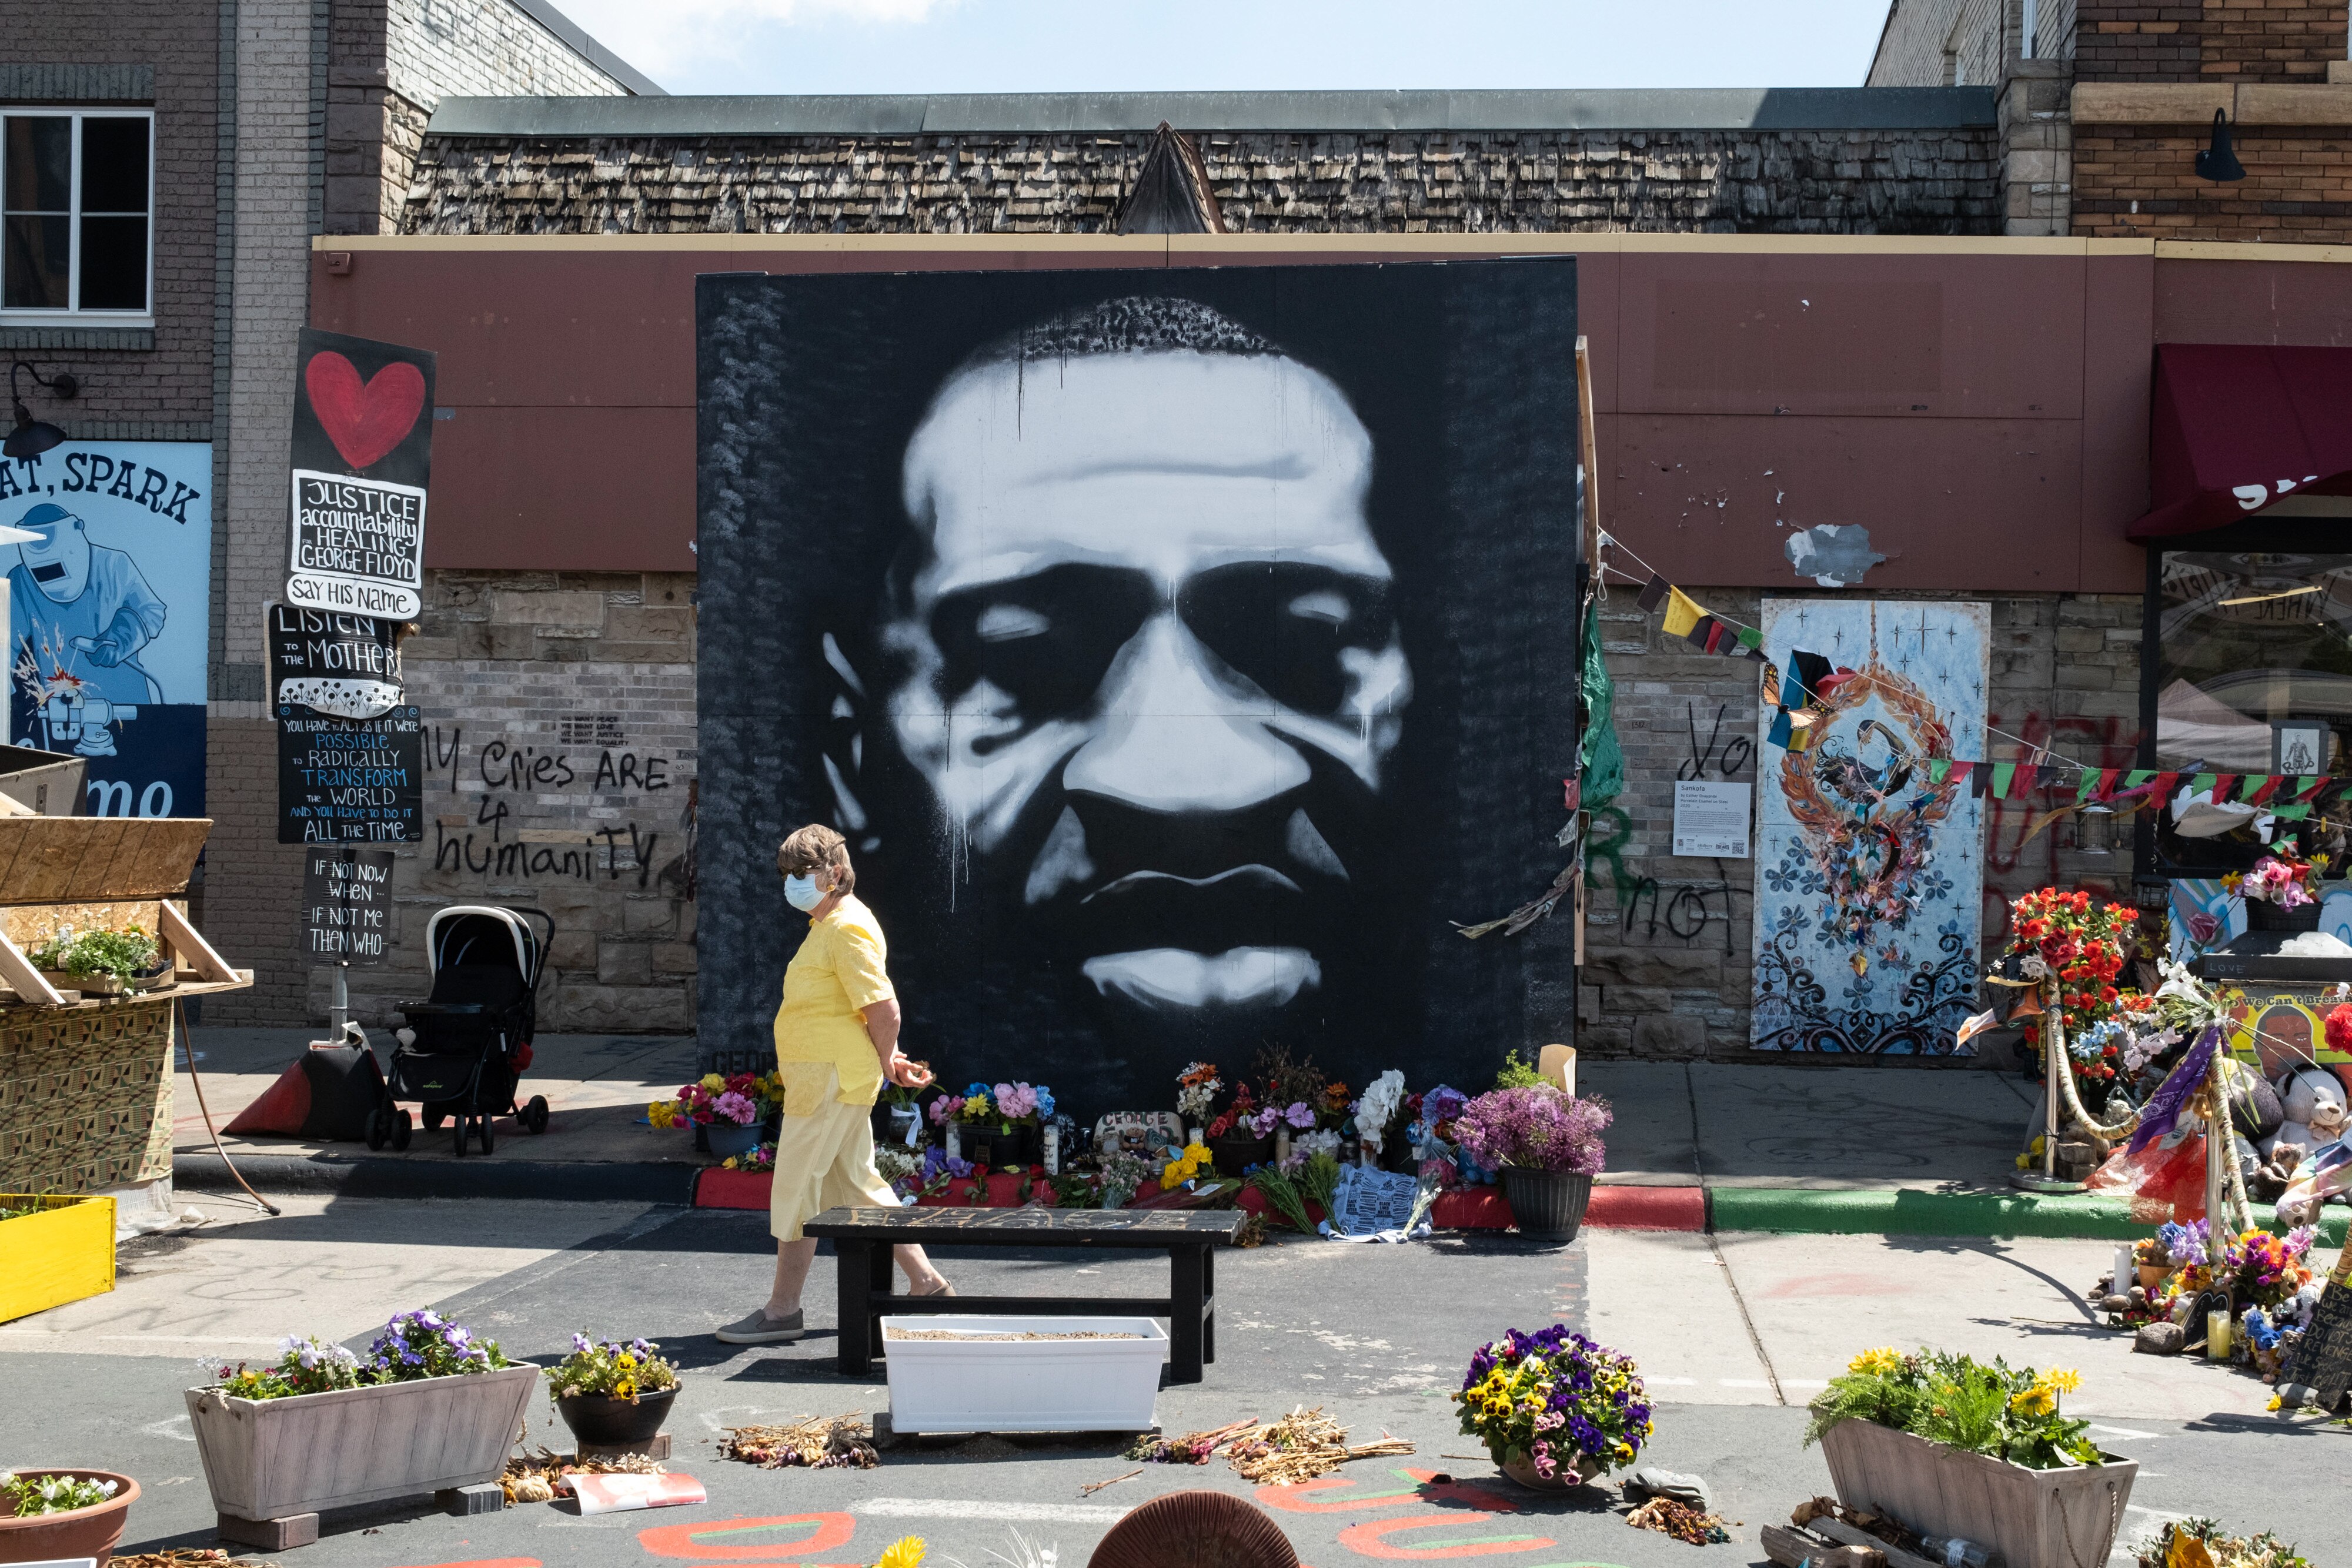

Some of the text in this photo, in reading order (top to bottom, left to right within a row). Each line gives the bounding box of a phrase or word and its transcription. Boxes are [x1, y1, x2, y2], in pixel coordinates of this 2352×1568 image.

[62, 452, 201, 525] SPARK
[308, 482, 416, 520] JUSTICE
[301, 509, 417, 547] accountability
[317, 527, 406, 557] HEALING
[301, 544, 416, 579] GEORGE FLOYD
[328, 583, 353, 604] HIS
[284, 720, 305, 733] YOU
[375, 720, 382, 733] IF
[385, 719, 392, 733] IT
[480, 740, 575, 791] Cries
[594, 750, 669, 791] ARE
[330, 788, 396, 806] WORLD
[290, 807, 311, 817] AND
[314, 806, 333, 817] YOU
[368, 809, 379, 818] TO
[384, 808, 399, 818] DO
[403, 808, 413, 818] IT
[305, 820, 338, 841] ALL
[315, 860, 387, 882] IF NOT NOW
[312, 907, 323, 923] IF
[330, 907, 358, 926] NOT
[2210, 962, 2246, 974] LOVE
[2241, 997, 2264, 1007] We
[2266, 995, 2302, 1006] Can't
